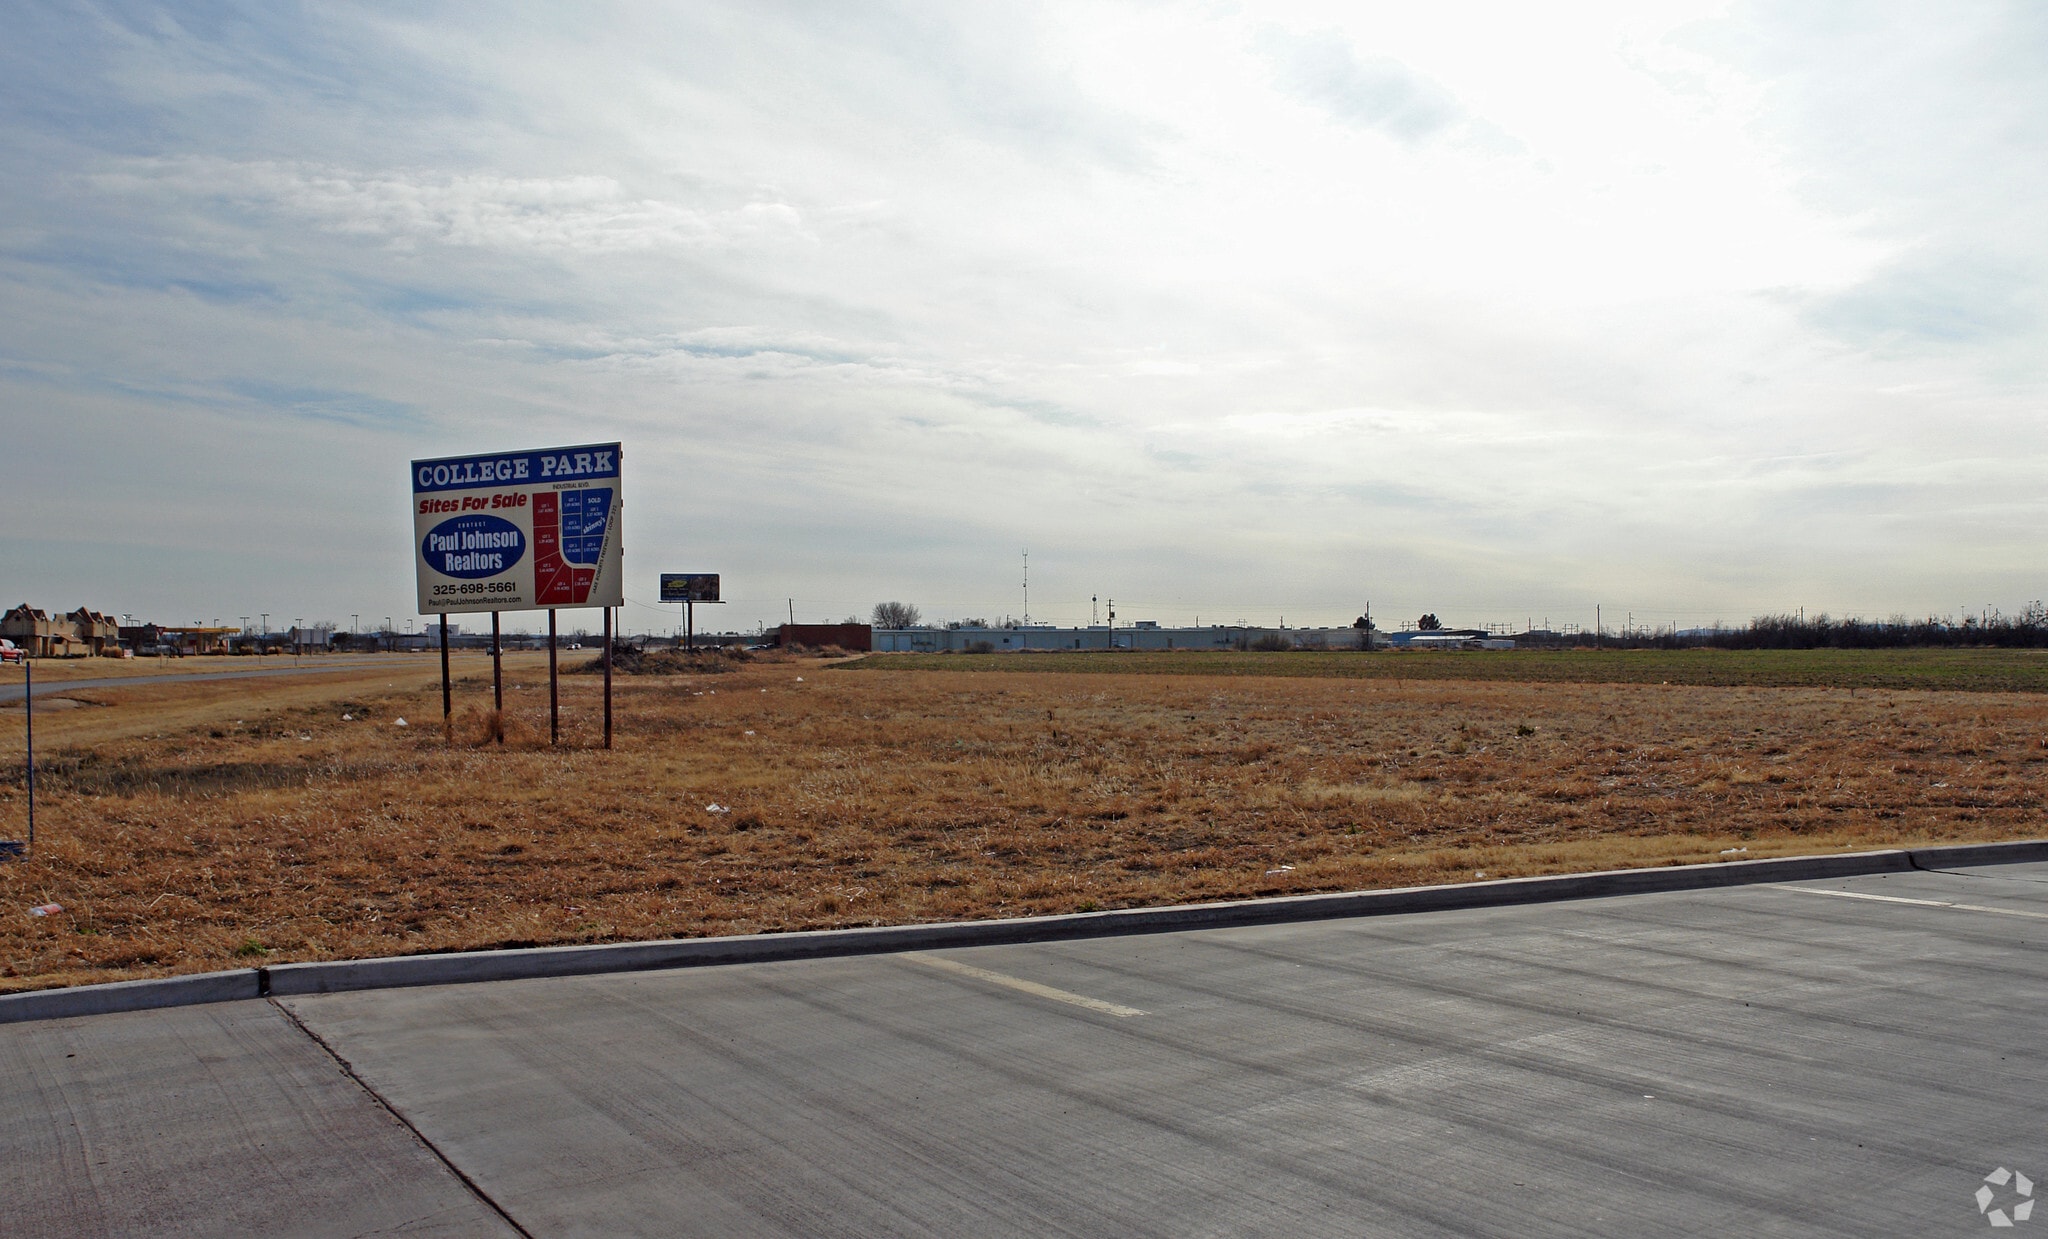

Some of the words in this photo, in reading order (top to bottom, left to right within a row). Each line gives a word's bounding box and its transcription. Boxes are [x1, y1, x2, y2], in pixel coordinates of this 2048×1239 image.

[418, 458, 529, 487] COLLEGE
[541, 451, 613, 477] PARK
[419, 498, 459, 514] Sites
[461, 495, 489, 511] For
[491, 492, 527, 509] Sale
[430, 532, 459, 552] Paul
[462, 530, 518, 550] Johnson
[446, 552, 502, 571] Realtors
[433, 582, 516, 595] 325-698-5661
[428, 596, 522, 607] Paul@PaulJohnsonRealtors.com
